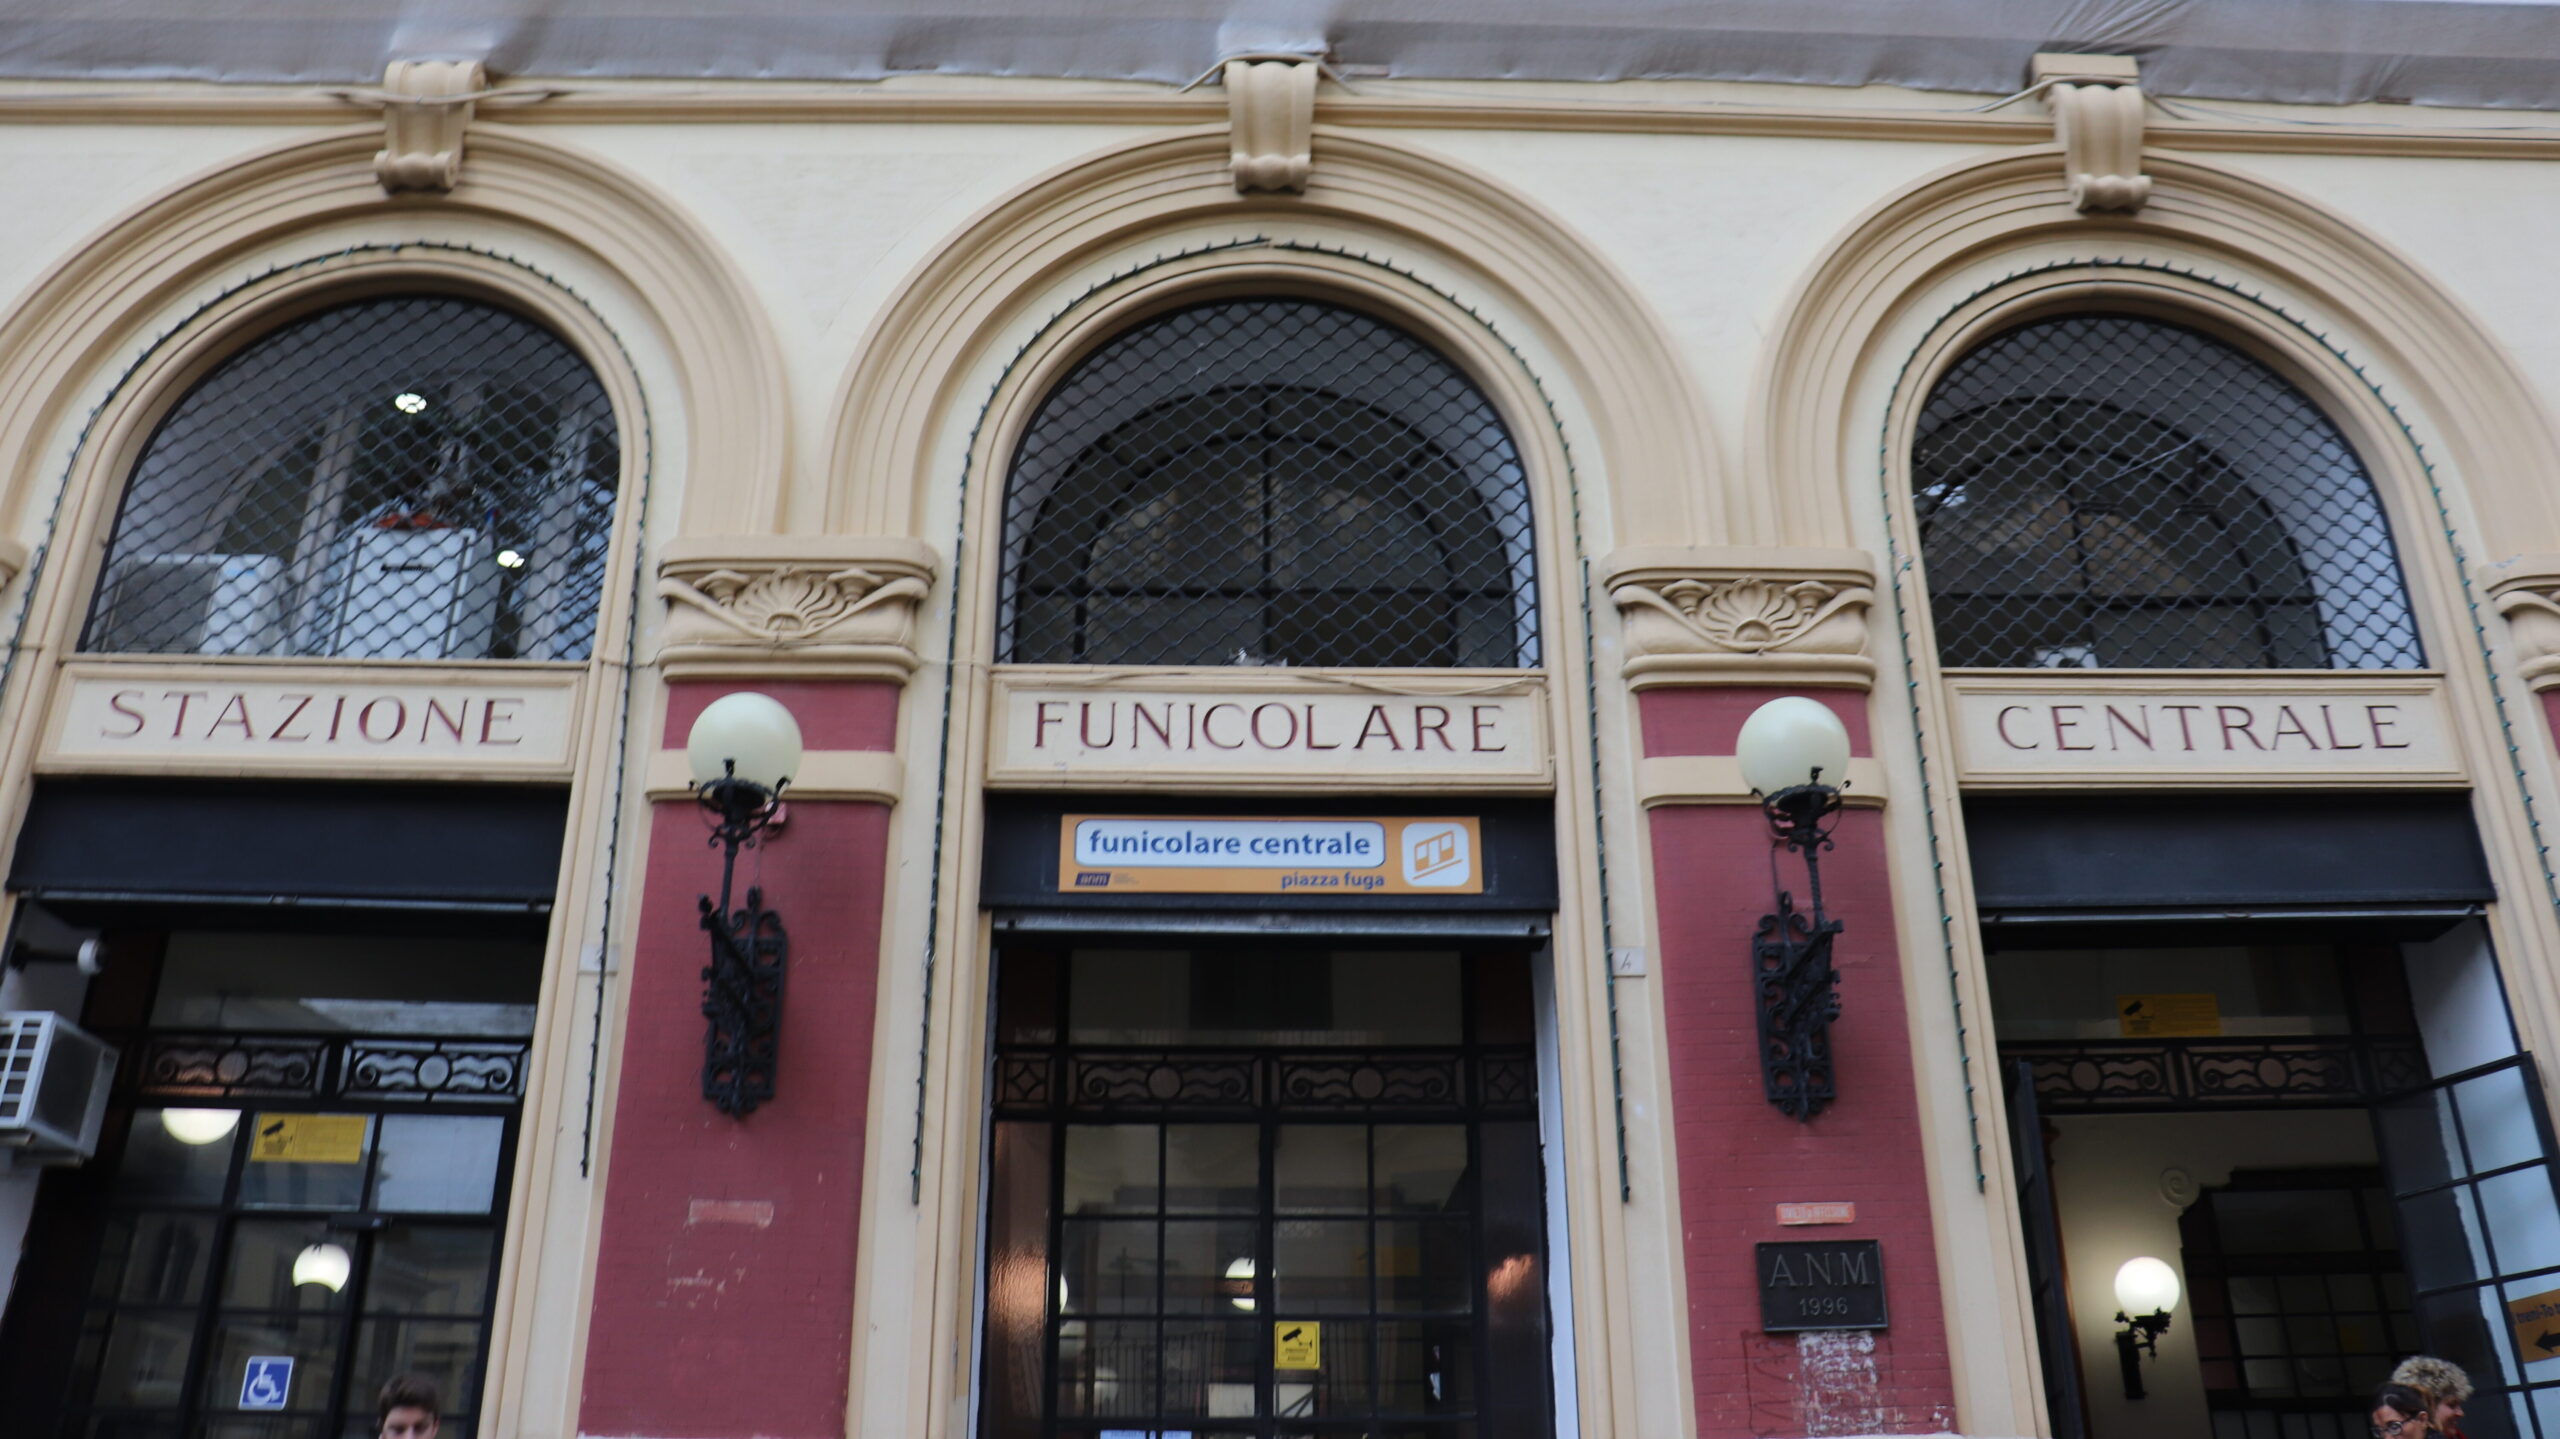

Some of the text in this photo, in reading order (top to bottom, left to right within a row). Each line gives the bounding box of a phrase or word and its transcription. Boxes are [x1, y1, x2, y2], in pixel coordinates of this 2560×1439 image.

[101, 690, 524, 746] STAZIONE
[1034, 701, 1507, 752] FUNICOLARE
[1997, 704, 2410, 751] CENTRALE
[1090, 829, 1371, 855] funicolare centrale
[1281, 871, 1385, 890] piazza fuga
[1800, 1297, 1848, 1316] 1996
